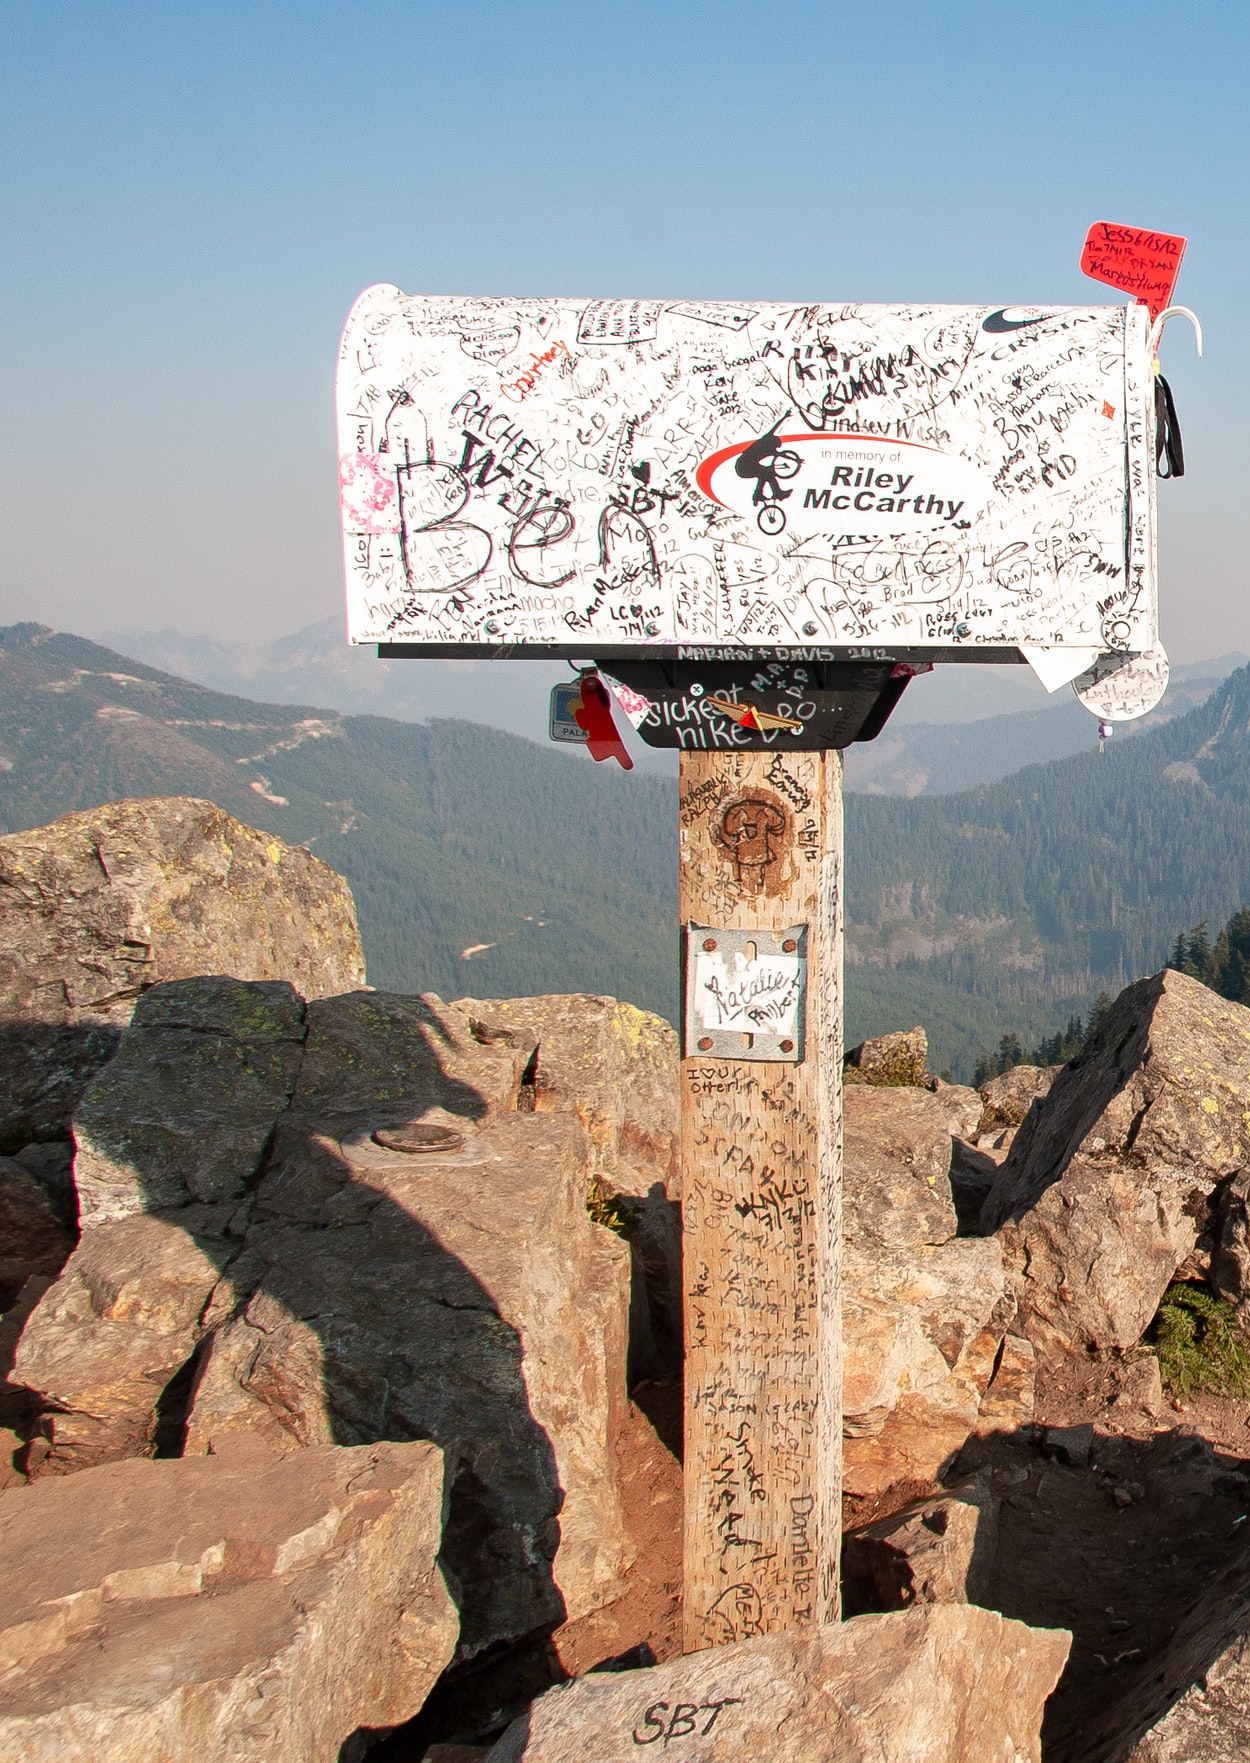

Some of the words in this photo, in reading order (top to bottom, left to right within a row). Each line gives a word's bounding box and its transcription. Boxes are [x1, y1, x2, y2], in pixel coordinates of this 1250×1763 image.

[450, 389, 546, 480] RACHEL
[821, 448, 832, 458] in
[835, 449, 885, 464] memory
[889, 451, 902, 462] of
[830, 465, 915, 494] Riley
[802, 488, 965, 521] McCarthy
[394, 459, 662, 593] Ben
[677, 645, 754, 661] MARIAN
[775, 647, 835, 661] DAVIS
[632, 1696, 747, 1749] SBT
